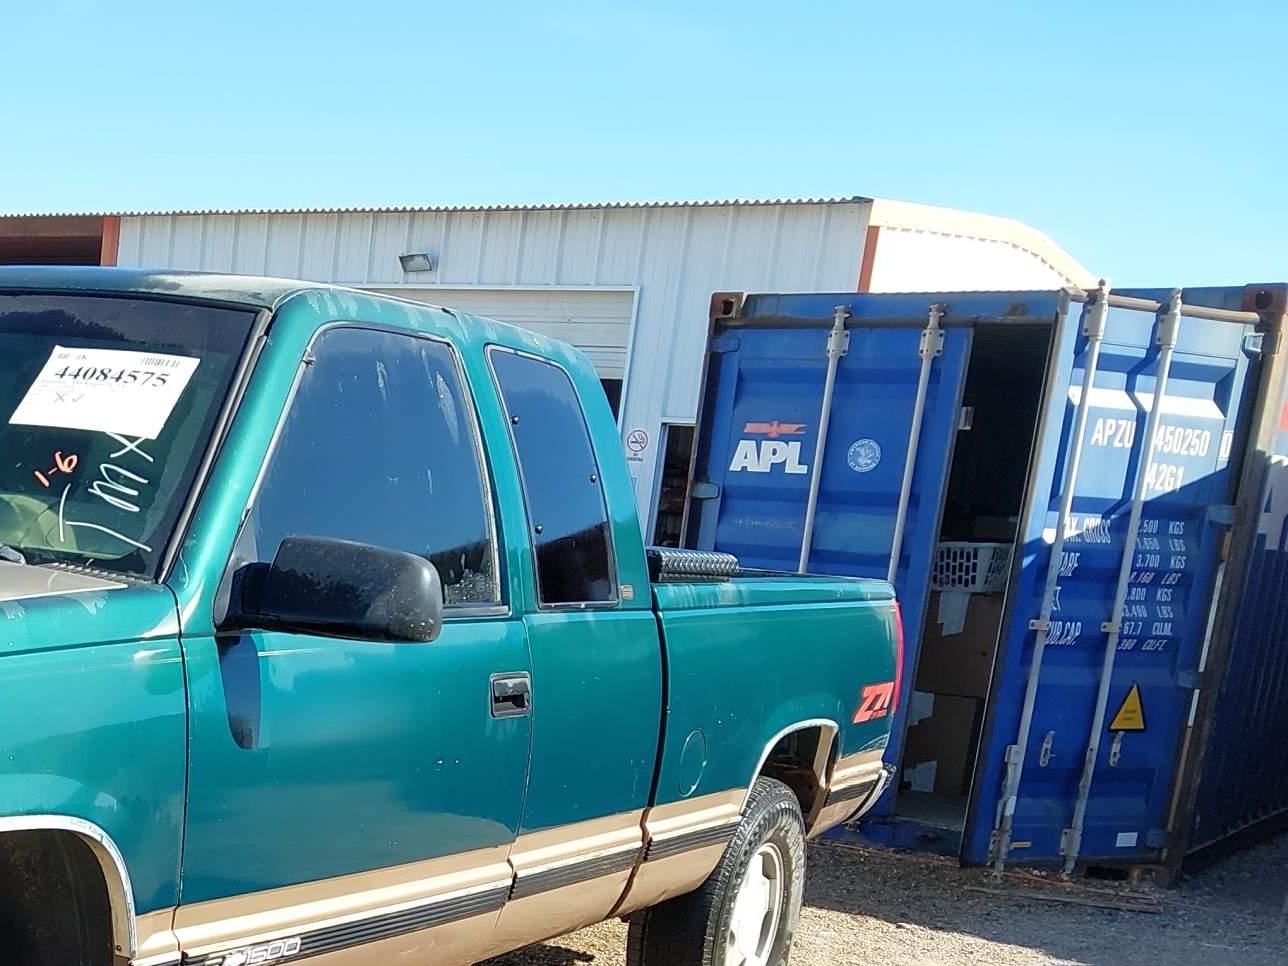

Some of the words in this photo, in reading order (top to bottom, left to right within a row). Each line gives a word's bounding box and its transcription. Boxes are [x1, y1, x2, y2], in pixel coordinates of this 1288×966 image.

[55, 365, 170, 388] 44084575
[1091, 417, 1136, 448] APZU
[1154, 425, 1211, 457] 450250
[33, 451, 79, 488] 1-6
[729, 439, 808, 475] APL
[1146, 463, 1185, 492] 42G1
[1083, 518, 1112, 544] GROSS
[1169, 521, 1185, 535] KGS
[1169, 538, 1186, 551] LBS
[1135, 554, 1160, 567] 3.700
[1169, 556, 1187, 569] KGS
[1156, 588, 1173, 601] KGS
[1156, 605, 1173, 617] LBS
[1123, 621, 1143, 634] 67.7
[853, 682, 894, 724] Z71
[246, 936, 302, 965] 1500
